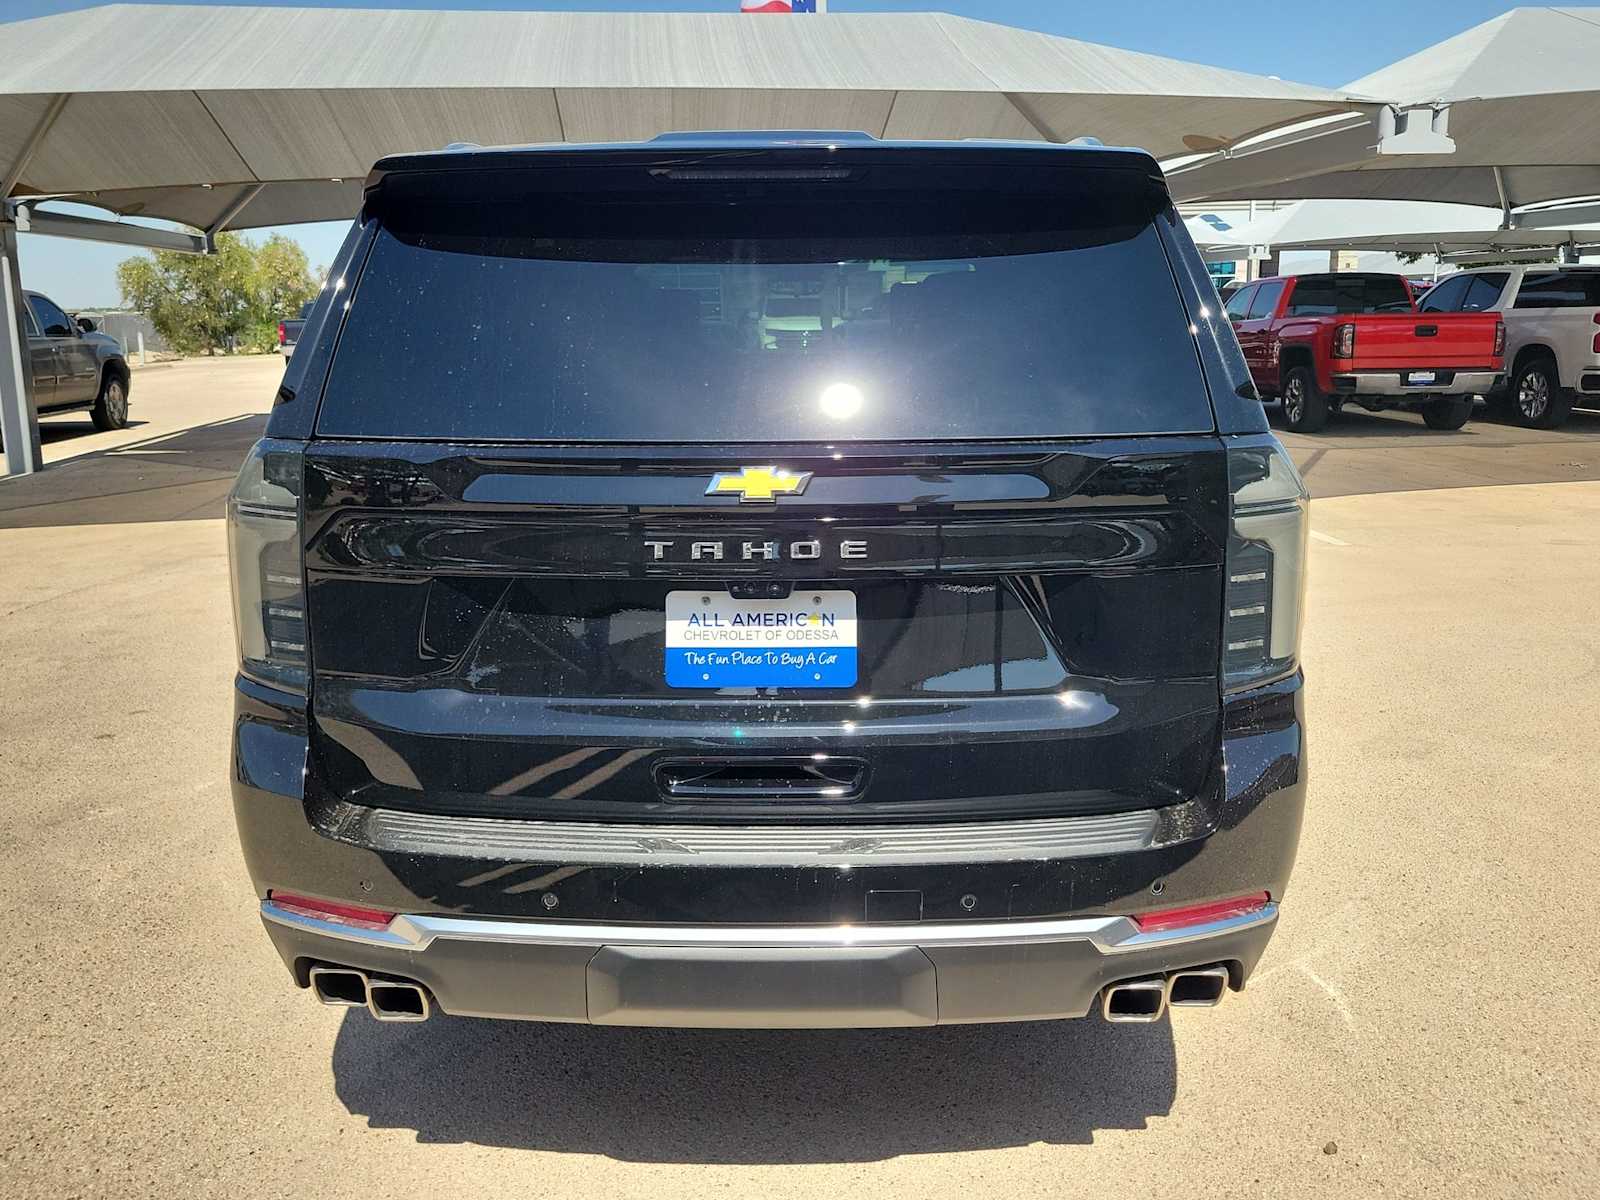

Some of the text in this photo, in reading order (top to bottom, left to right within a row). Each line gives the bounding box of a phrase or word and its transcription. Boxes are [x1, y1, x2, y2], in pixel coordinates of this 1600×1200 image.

[644, 541, 868, 560] TAHOE
[688, 613, 834, 627] ALL AMERICN
[683, 629, 839, 641] CHEVROLET OF ODESSA
[684, 651, 838, 669] The Fun Place To Buy A Car
